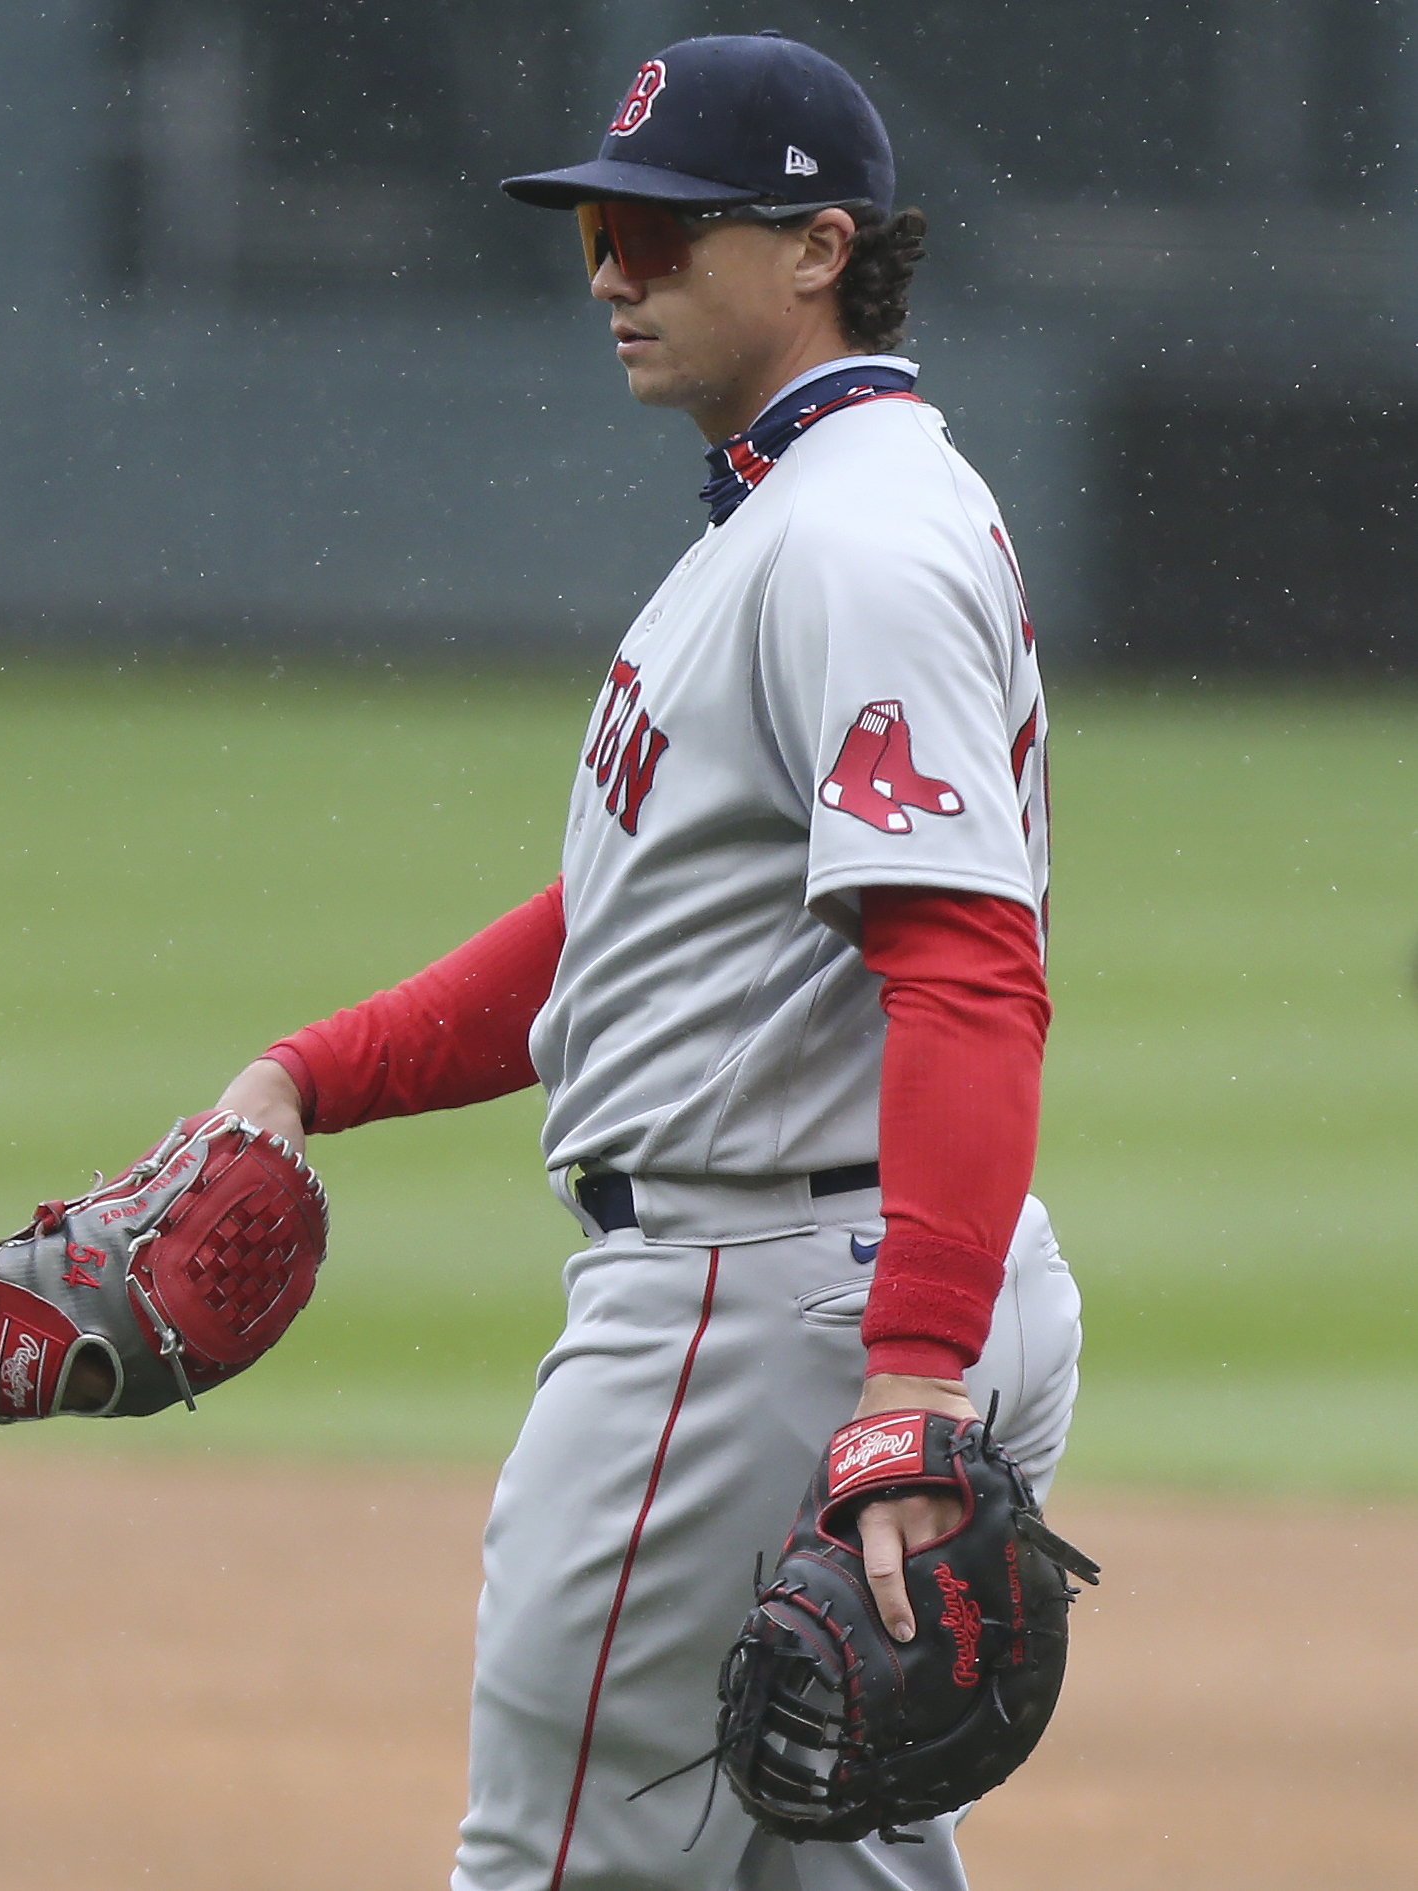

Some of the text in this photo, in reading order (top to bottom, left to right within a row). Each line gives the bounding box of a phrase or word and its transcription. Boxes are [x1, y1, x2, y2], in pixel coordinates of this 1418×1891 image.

[609, 58, 667, 136] B
[61, 1242, 107, 1289] 54
[835, 1430, 914, 1475] Rawlings
[932, 1561, 981, 1688] Rawlings
